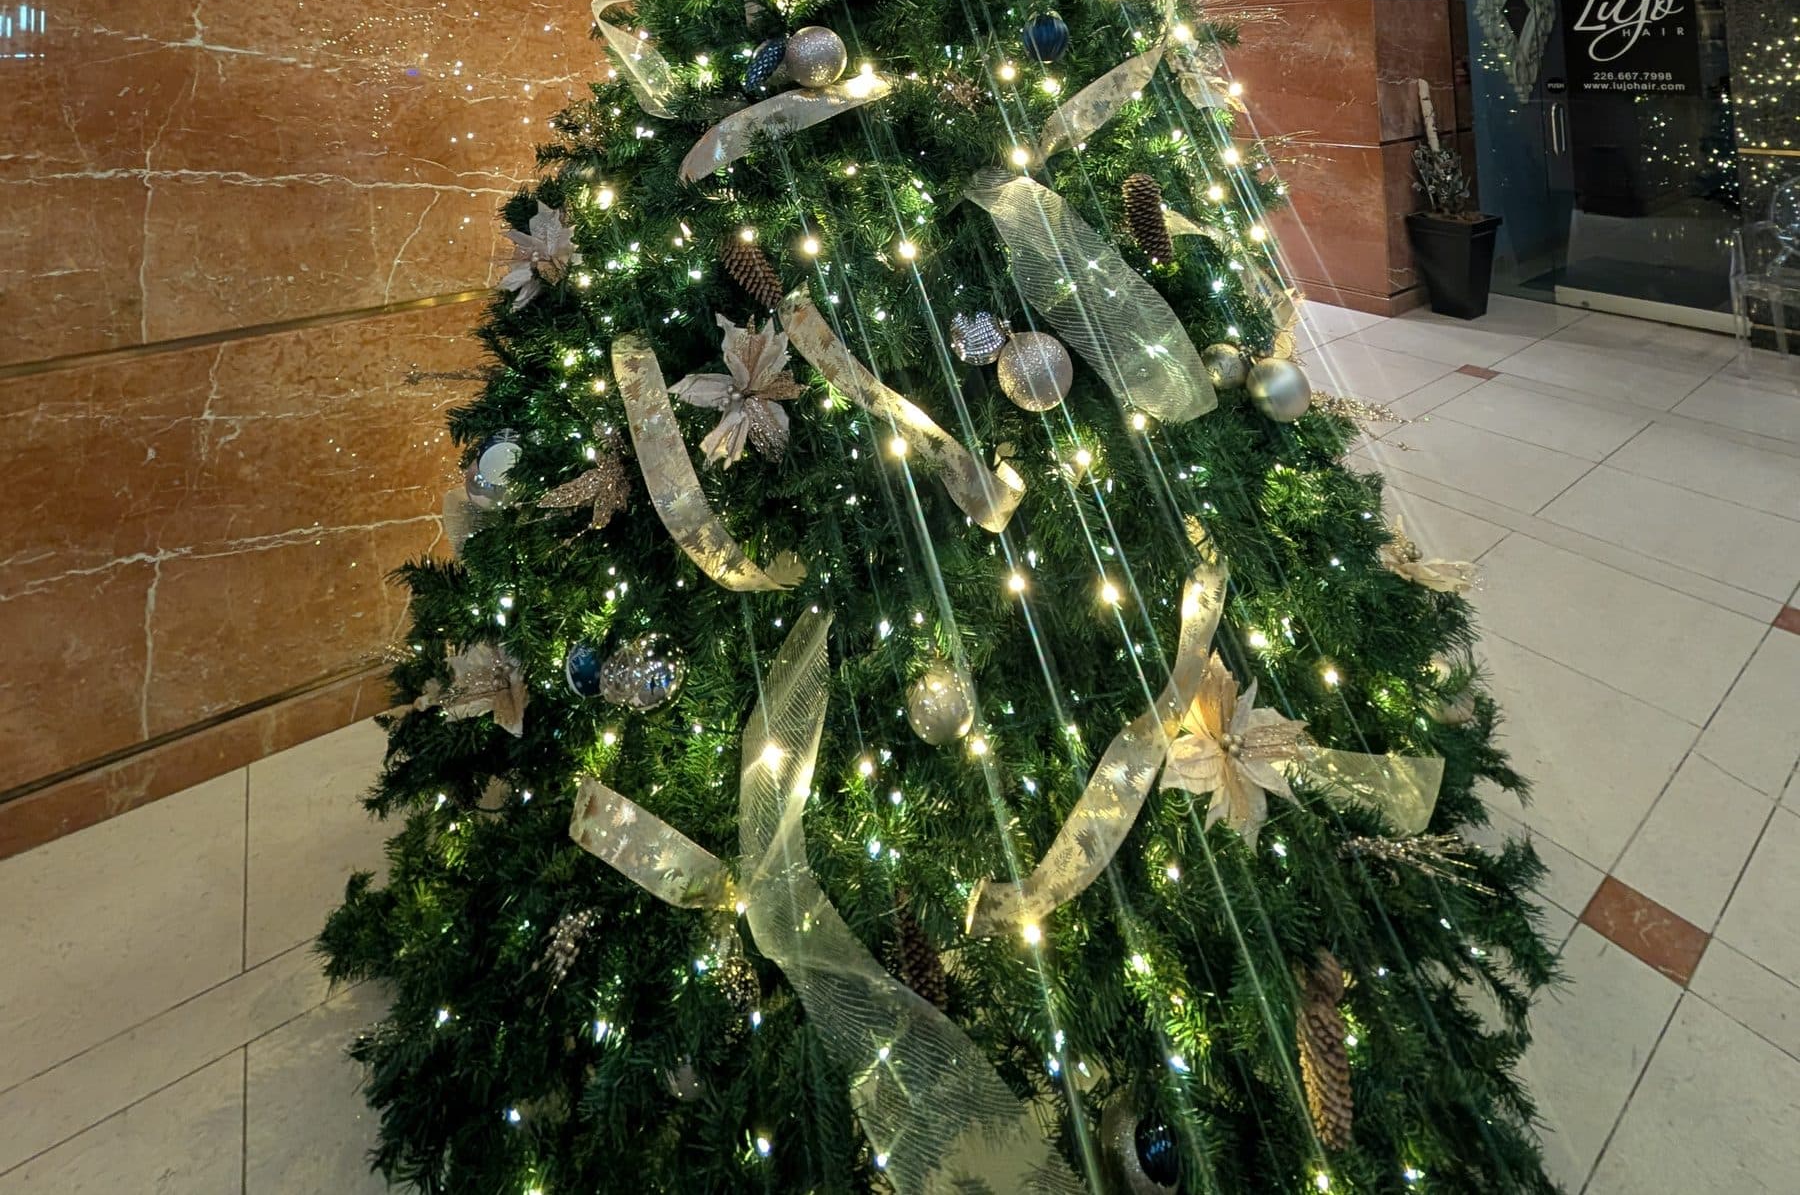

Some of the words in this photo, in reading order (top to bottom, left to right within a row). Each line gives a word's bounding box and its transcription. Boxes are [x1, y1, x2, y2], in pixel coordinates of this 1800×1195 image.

[1622, 27, 1684, 36] HAIR
[1593, 72, 1672, 80] 226.667.7998
[1583, 82, 1685, 91] www.lujohair.com
